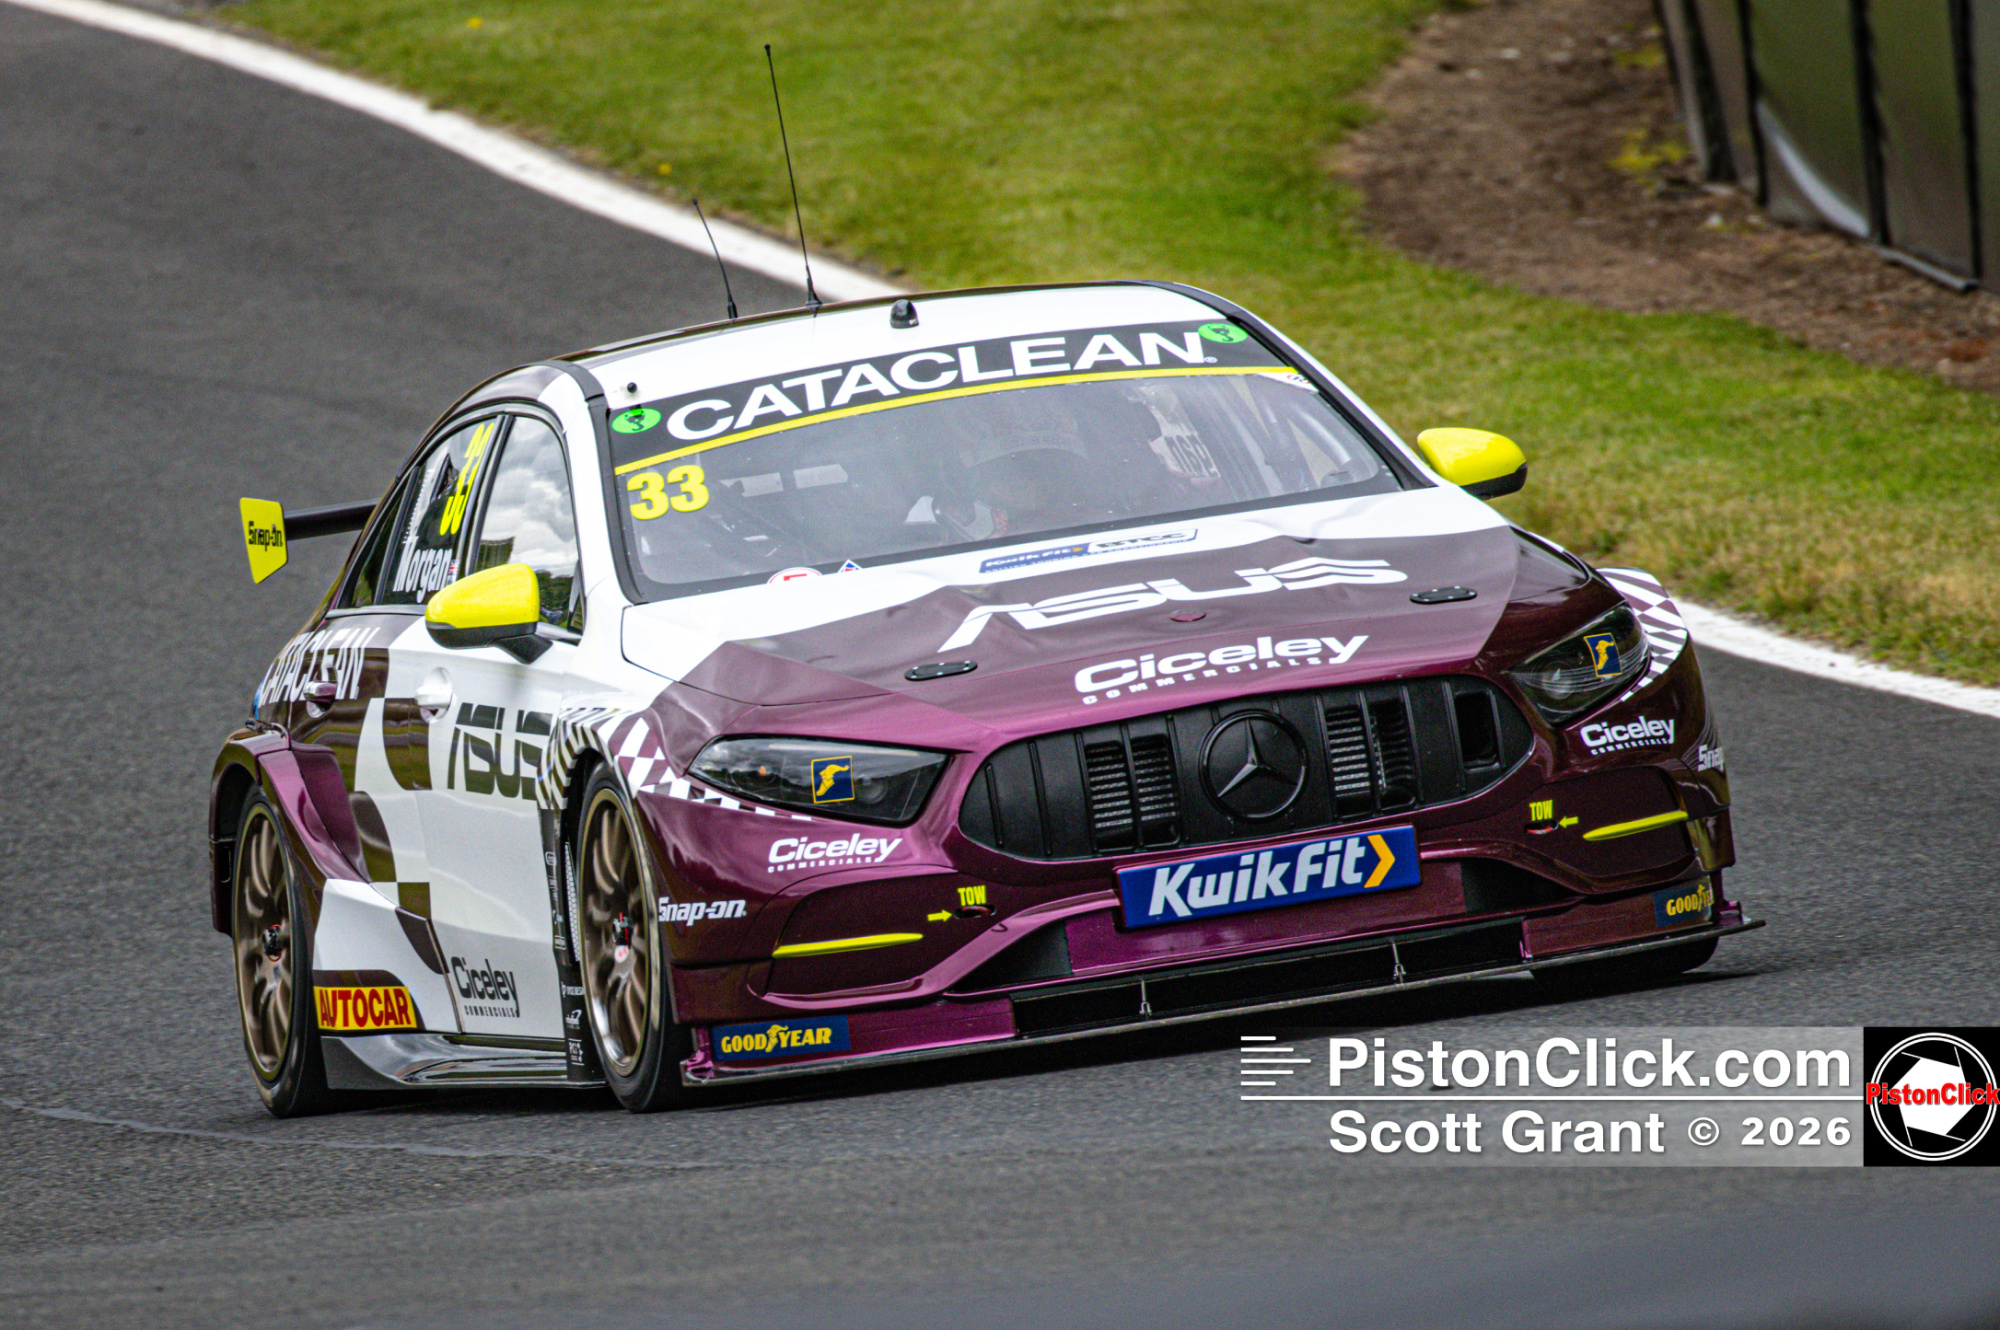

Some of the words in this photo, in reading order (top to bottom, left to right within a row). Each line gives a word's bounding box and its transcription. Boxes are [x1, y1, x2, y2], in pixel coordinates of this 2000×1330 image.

[440, 422, 495, 536] 33
[626, 464, 710, 520] 33
[392, 535, 453, 604] Morgan
[937, 557, 1408, 653] ASUS
[1074, 635, 1369, 693] Ciceley
[1082, 656, 1322, 704] COMMERCIALS
[1580, 715, 1675, 747] Ciceley
[1590, 737, 1668, 755] COMMERCIALS
[447, 702, 553, 801] ASUS
[1529, 800, 1553, 821] TOW
[767, 833, 902, 863] Ciceley
[767, 857, 874, 873] COMMERCIALS
[658, 897, 746, 926] Snap-on
[957, 885, 986, 906] TOW
[450, 956, 520, 1018] Ciceley
[319, 988, 412, 1028] AUTOCAR
[464, 1004, 517, 1018] COMMERCIALS
[721, 1025, 832, 1053] GOODYEAR
